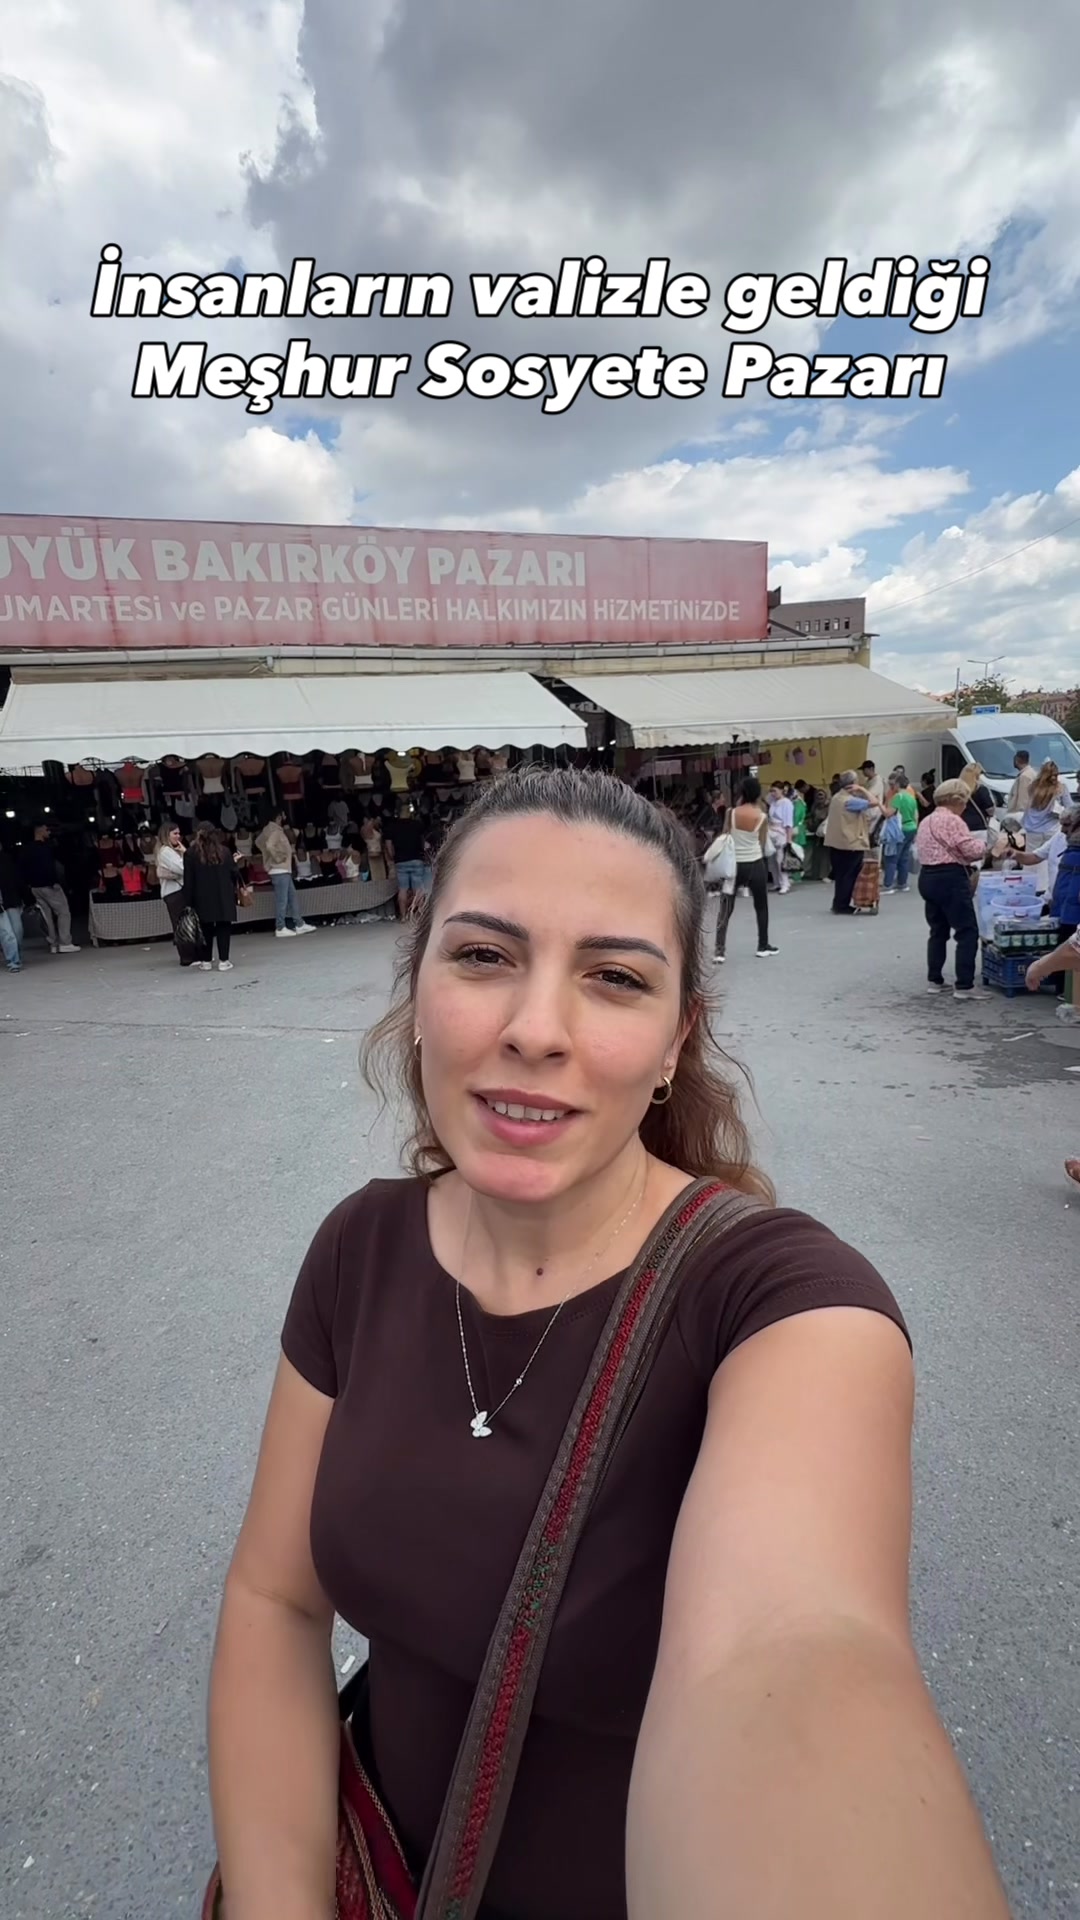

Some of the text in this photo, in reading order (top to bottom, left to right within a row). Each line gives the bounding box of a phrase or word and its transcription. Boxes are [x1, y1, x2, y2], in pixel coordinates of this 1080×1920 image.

[0, 527, 586, 586] YÜK BAKIRKÖY PAZARI
[170, 600, 206, 621] ve
[214, 596, 315, 621] PAZAR
[446, 598, 587, 621] HALKIMIZIN
